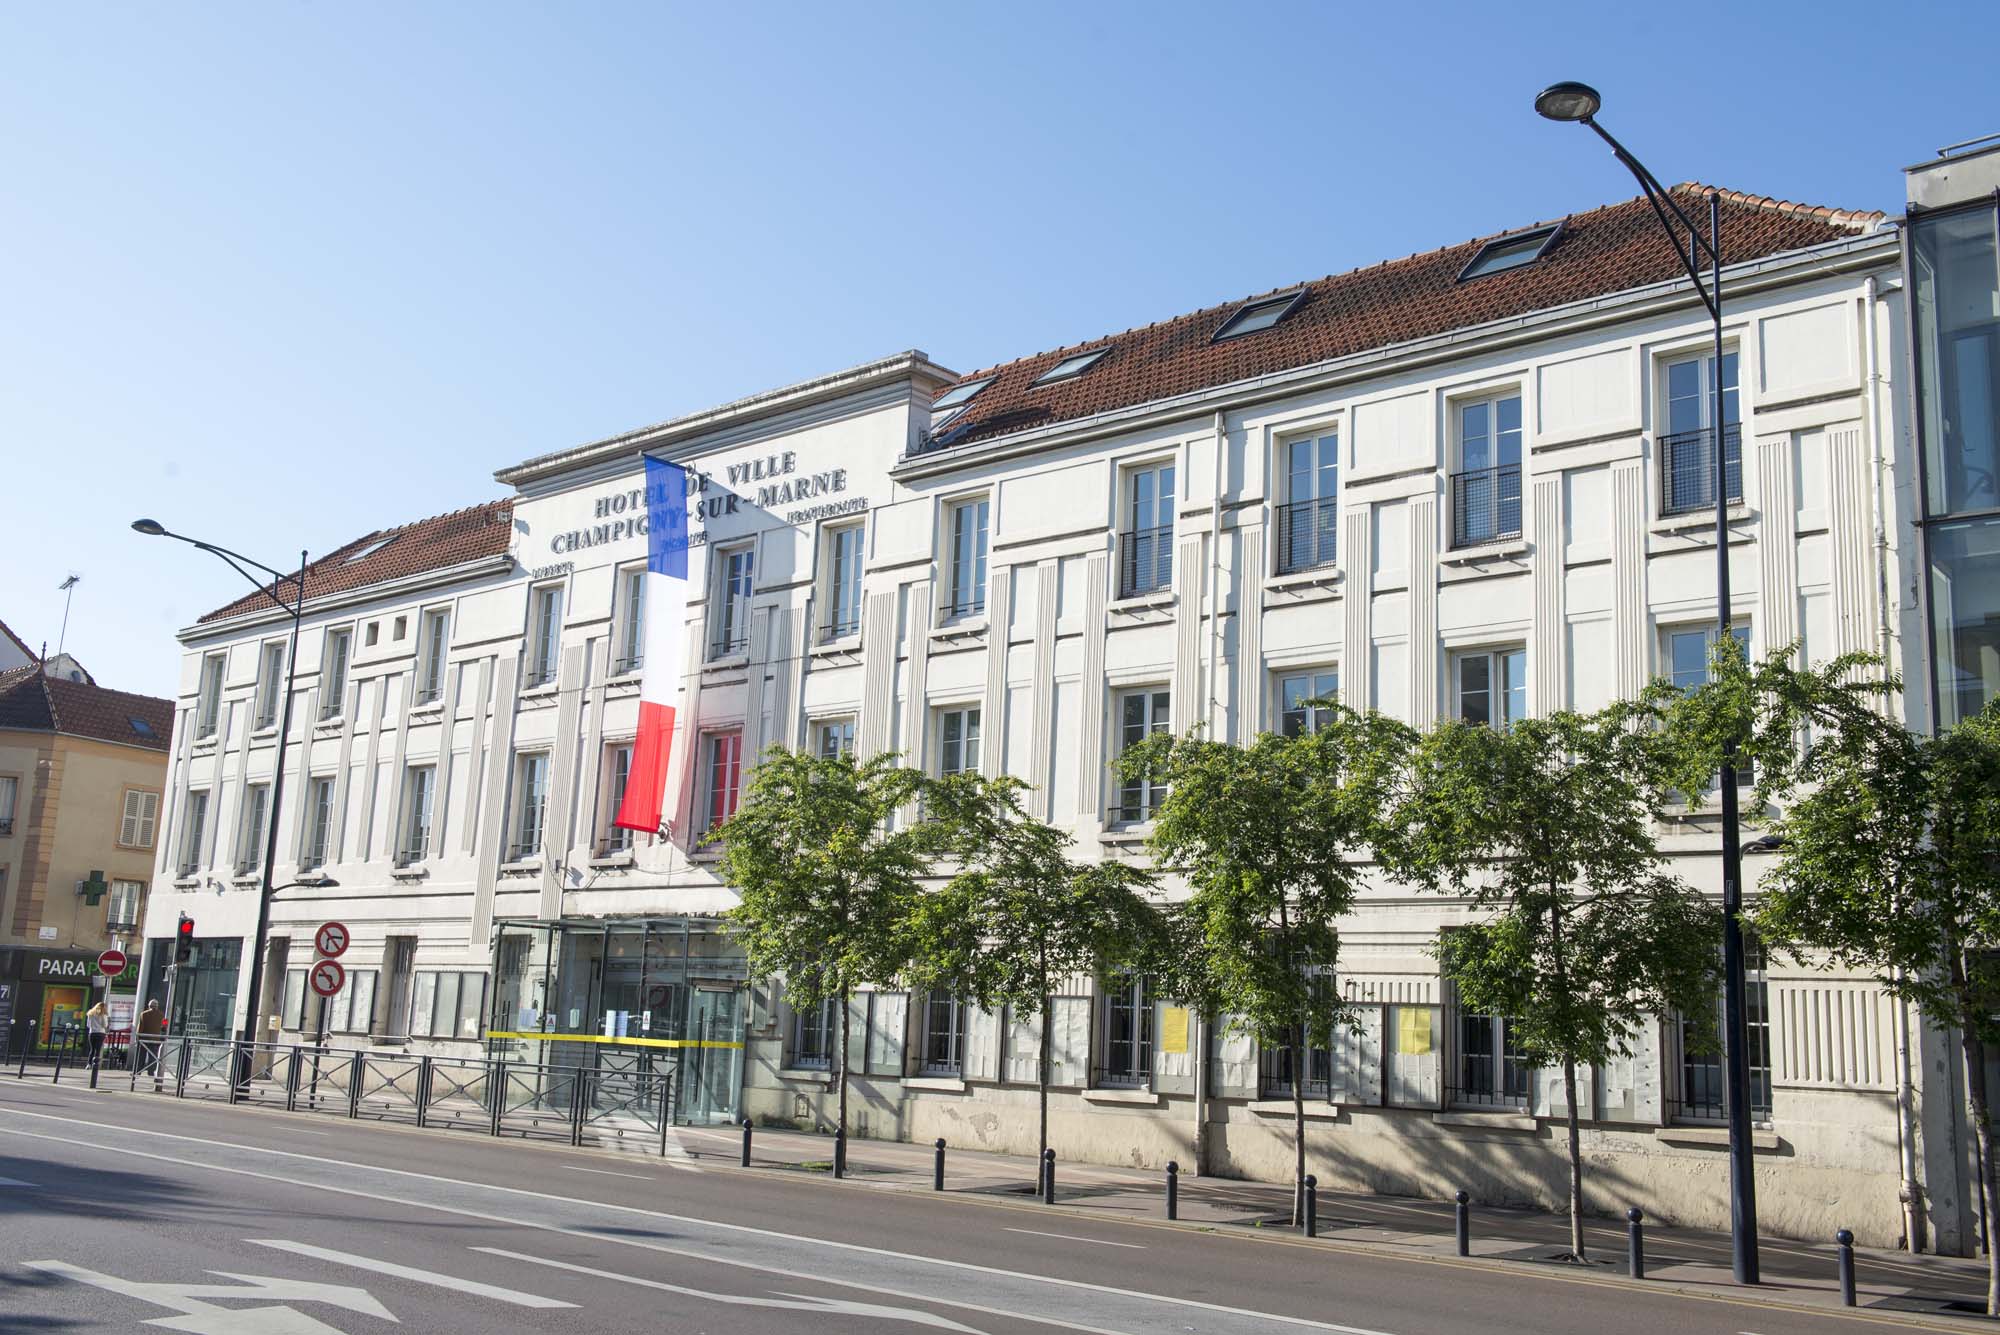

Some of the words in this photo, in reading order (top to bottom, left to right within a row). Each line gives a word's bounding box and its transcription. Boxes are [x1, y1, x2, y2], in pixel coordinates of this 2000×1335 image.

[594, 484, 670, 519] HOTEL
[681, 471, 712, 498] DE
[726, 450, 797, 487] VILLE
